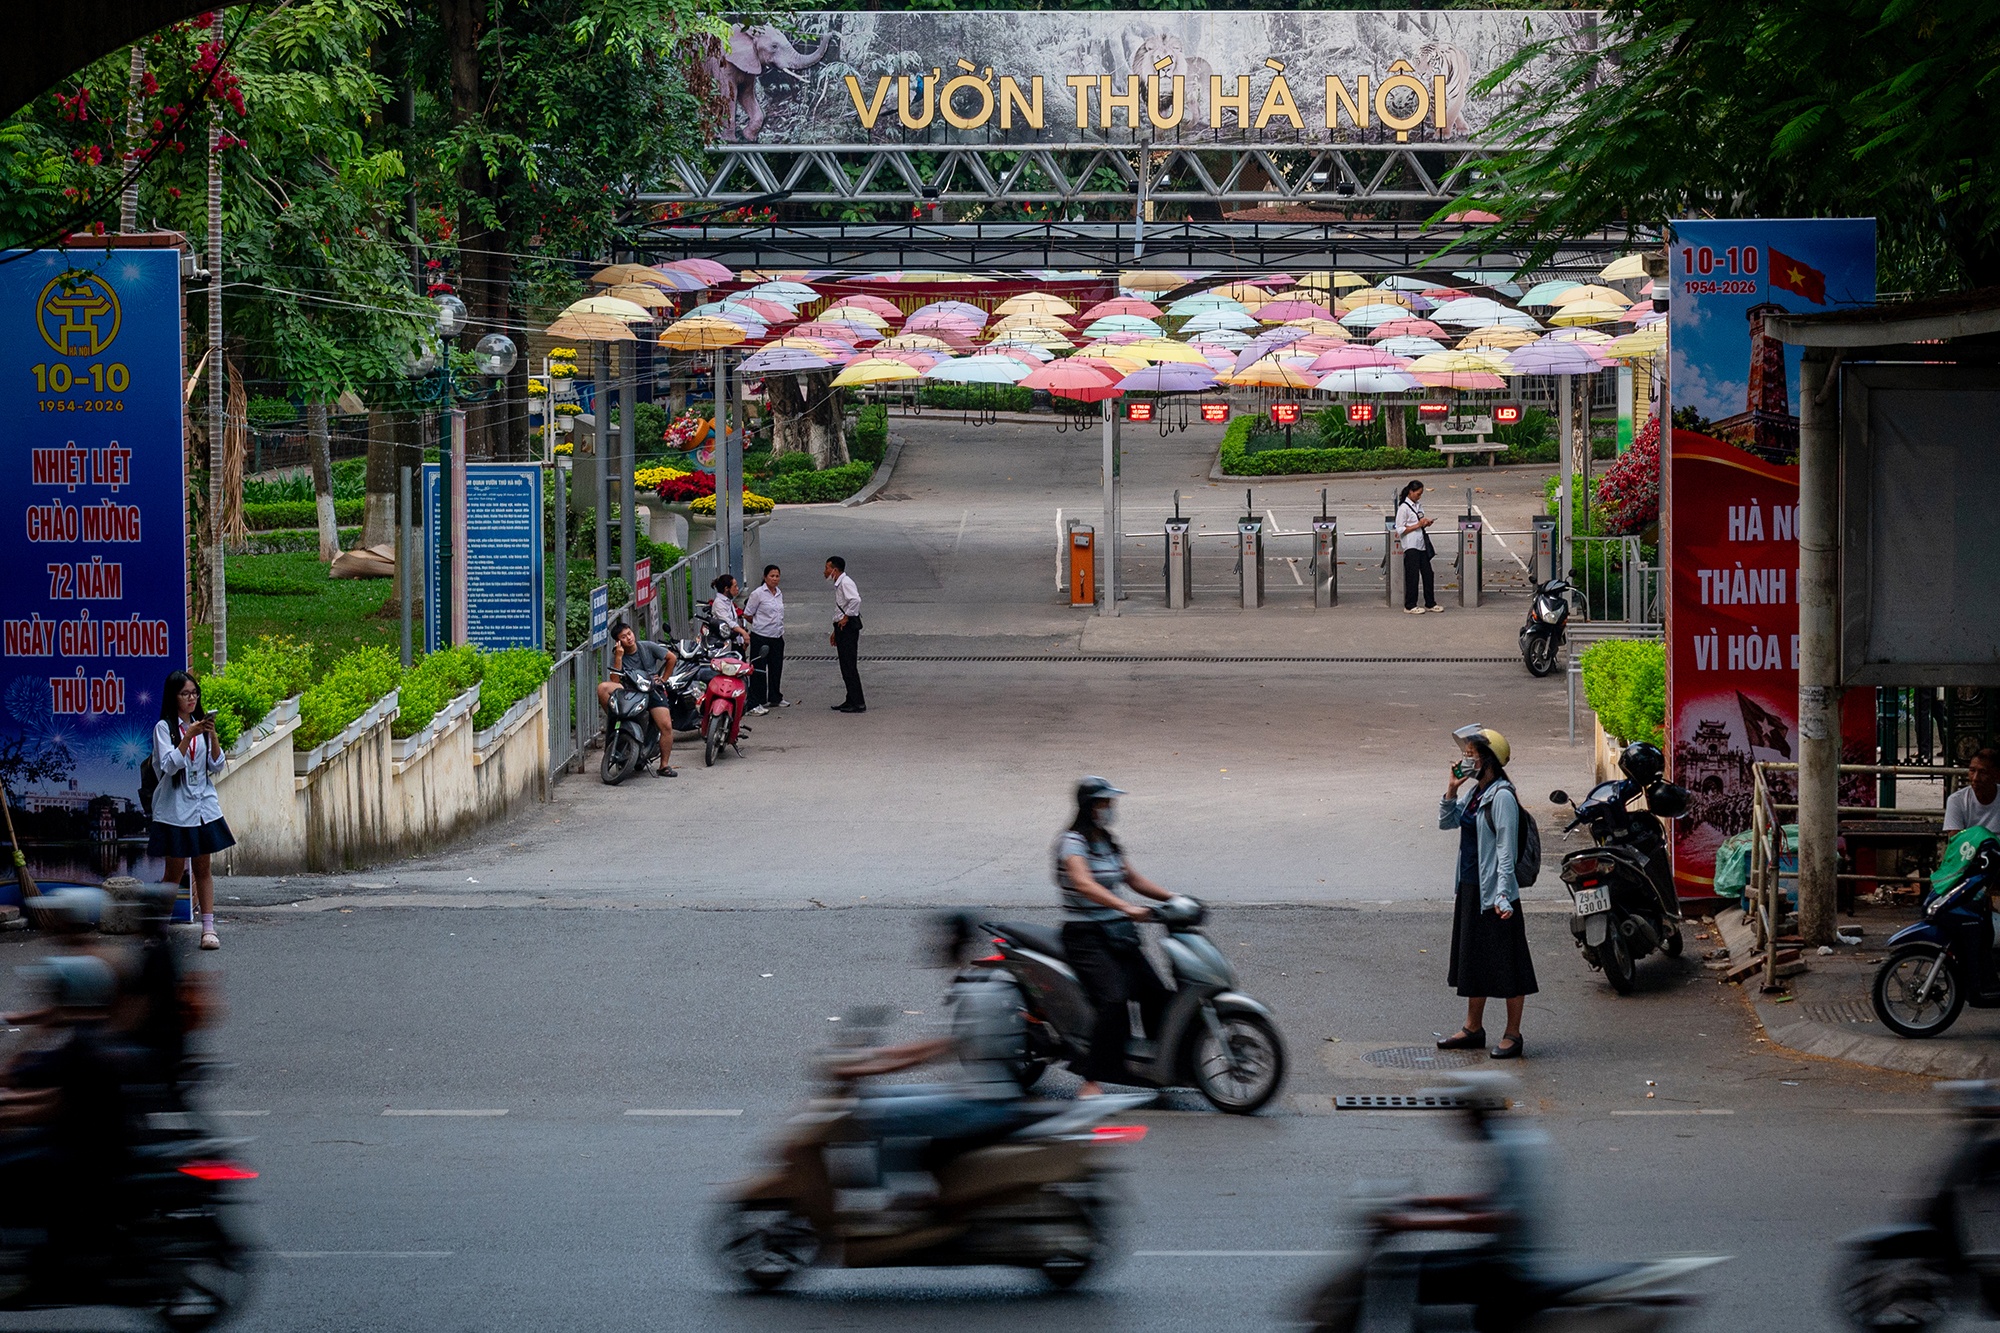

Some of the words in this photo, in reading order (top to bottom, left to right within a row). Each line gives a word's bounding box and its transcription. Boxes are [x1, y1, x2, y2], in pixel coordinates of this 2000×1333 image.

[844, 58, 1045, 130] VƯỜN
[1066, 56, 1185, 130] THÚ
[1210, 57, 1304, 130] HÀ
[1325, 59, 1447, 142] NỘI
[1682, 246, 1759, 275] 10-10
[1684, 280, 1757, 295] 1954-2026
[69, 344, 77, 356] HÀ
[79, 344, 90, 358] NỘI
[31, 362, 130, 393] 10-10
[38, 400, 124, 412] 1954-2026
[1498, 409, 1516, 418] LED
[32, 440, 87, 492] NHIỆT
[91, 440, 132, 492] LIỆT
[26, 499, 78, 543] CHÀO
[83, 498, 141, 543] MỪNG
[1728, 498, 1764, 541] HÀ
[47, 564, 74, 599] 72
[76, 556, 122, 599] NĂM
[1697, 561, 1786, 605] THÀNH
[4, 613, 55, 656] NGÀY
[59, 608, 100, 656] GIẢI
[103, 613, 169, 656] PHÓNG
[1694, 627, 1718, 671] VÌ
[1728, 626, 1782, 670] HÒA
[50, 666, 86, 714] THỦ
[91, 670, 125, 714] ĐÔ!
[1579, 899, 1607, 914] 430.01
